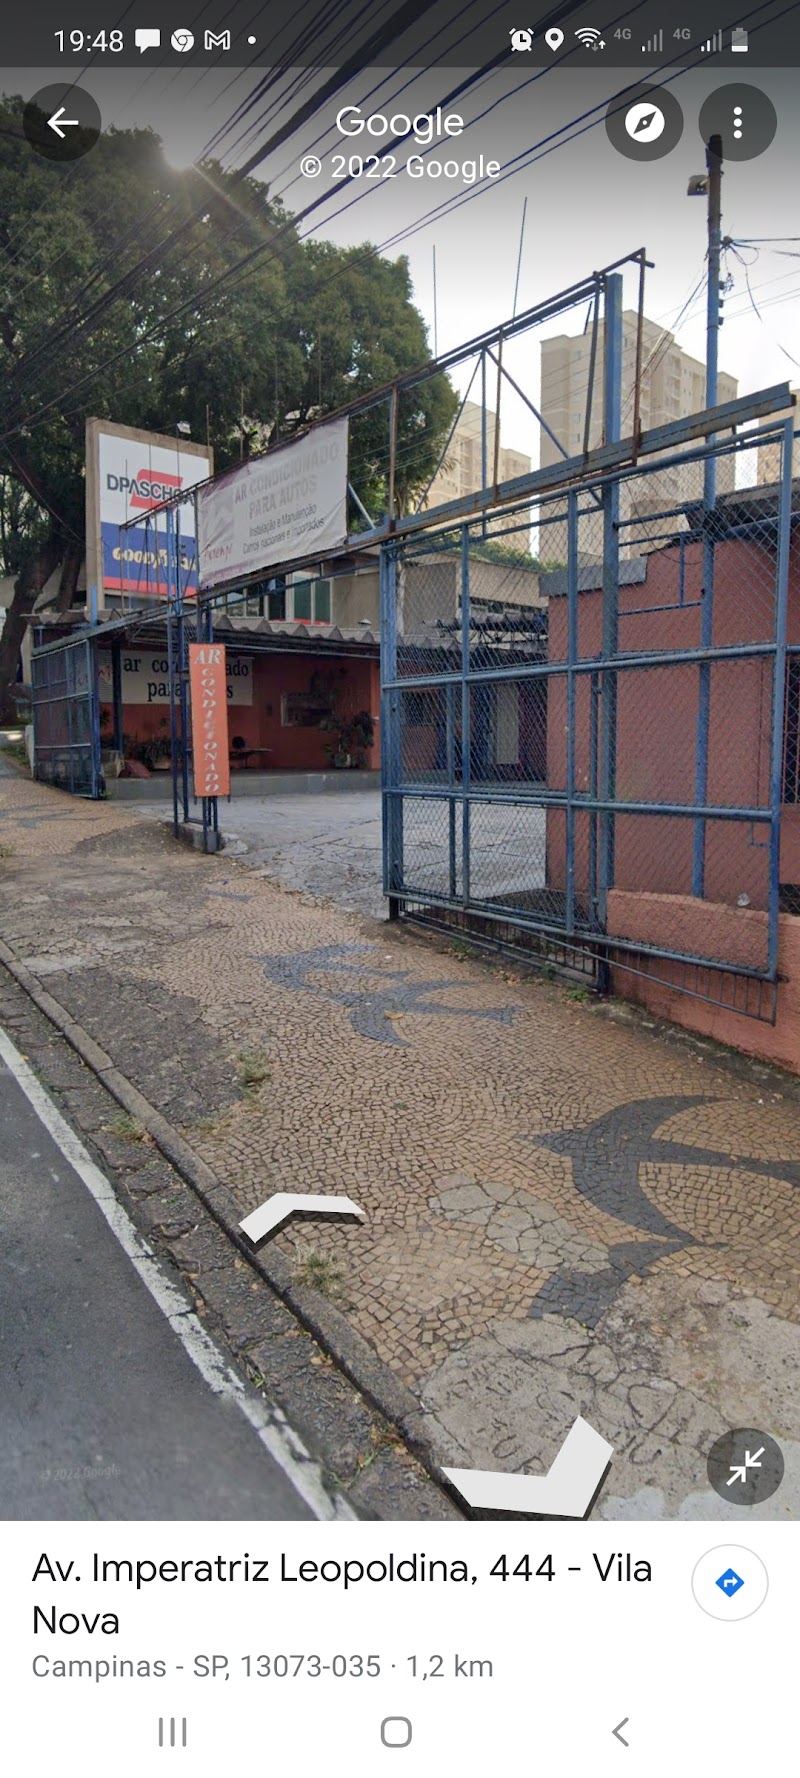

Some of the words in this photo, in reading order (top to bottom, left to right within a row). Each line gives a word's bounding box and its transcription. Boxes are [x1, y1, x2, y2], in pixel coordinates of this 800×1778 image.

[248, 494, 277, 519] PARA
[123, 656, 142, 672] ar
[193, 648, 222, 665] AR
[200, 667, 220, 792] CONDICIONADO
